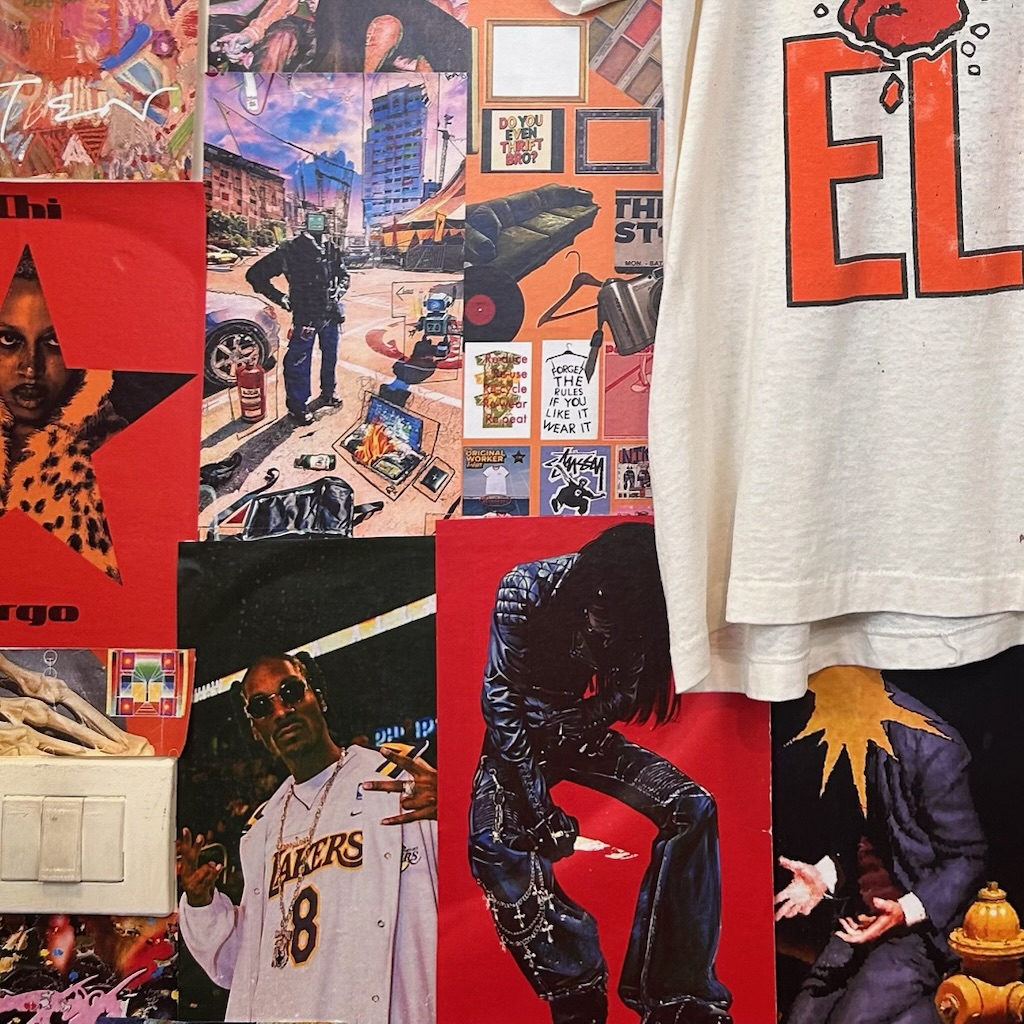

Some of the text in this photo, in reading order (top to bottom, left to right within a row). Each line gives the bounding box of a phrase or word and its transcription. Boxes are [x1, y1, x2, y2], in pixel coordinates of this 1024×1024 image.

[499, 114, 543, 129] DO YOU
[505, 127, 537, 141] EVEN
[500, 139, 544, 155] THRIFT
[506, 152, 537, 166] BRO?
[551, 365, 585, 376] FORGET
[553, 376, 584, 387] THE
[554, 387, 584, 396] RULES
[549, 396, 587, 407] IF YOU
[546, 408, 589, 419] LIKE IT
[543, 419, 591, 434] WEAR IT
[268, 830, 364, 899] LAKERS
[290, 886, 320, 965] 8
